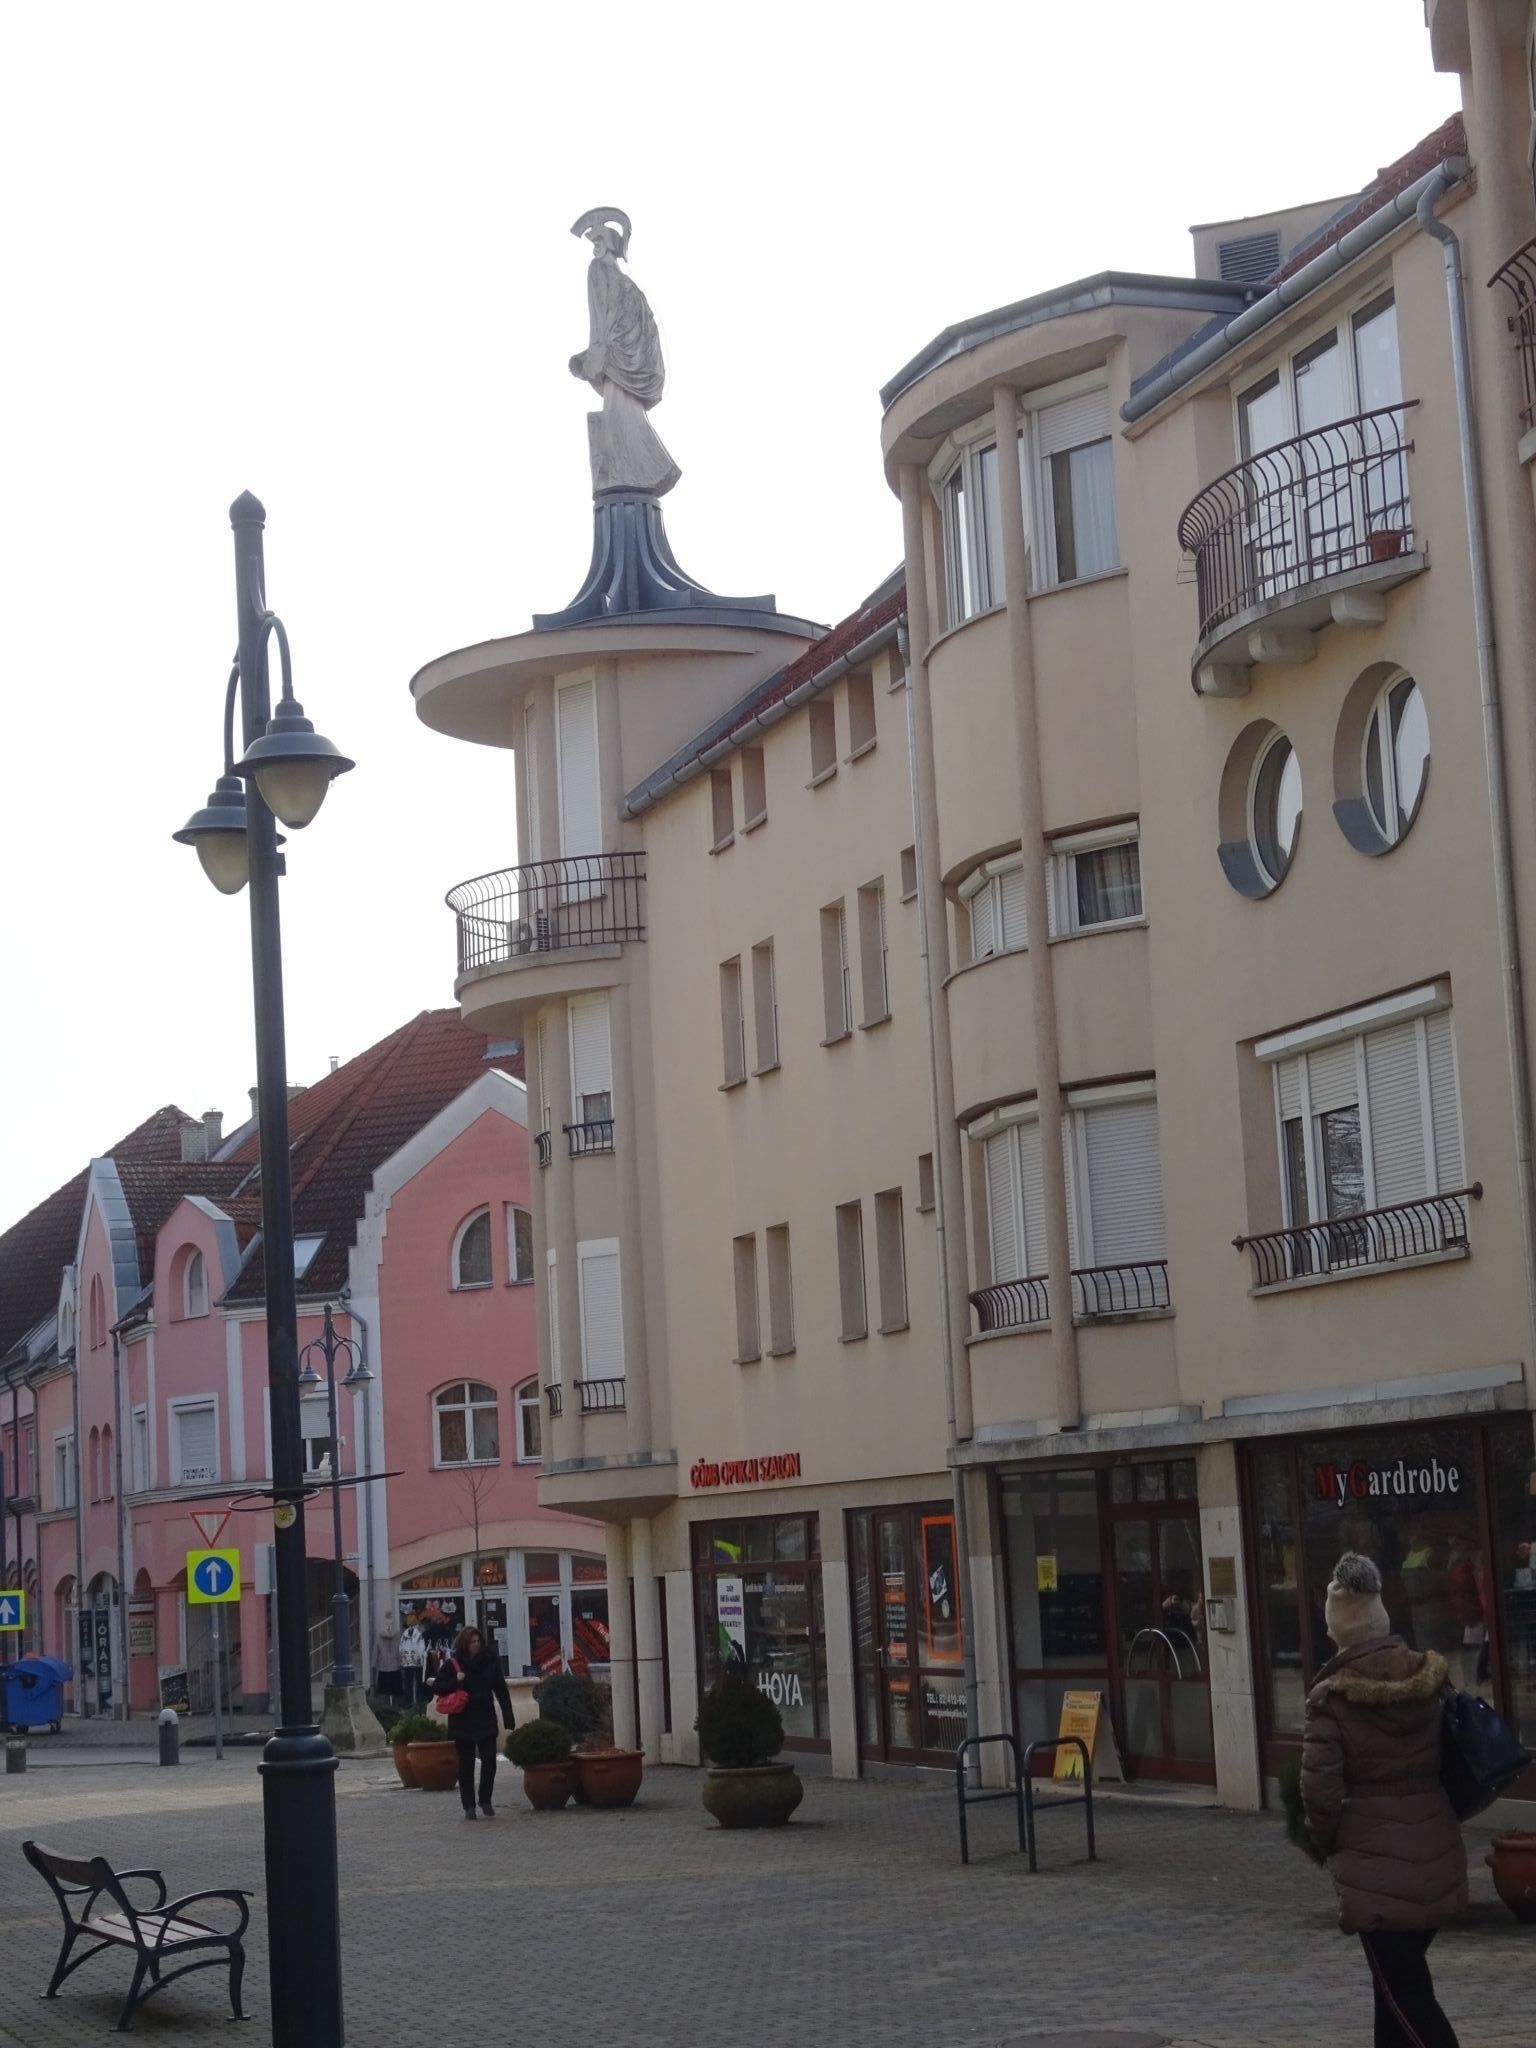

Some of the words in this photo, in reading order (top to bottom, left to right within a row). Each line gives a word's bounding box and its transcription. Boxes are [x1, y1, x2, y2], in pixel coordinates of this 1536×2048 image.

[690, 1457, 720, 1488] GÖMB
[720, 1458, 759, 1485] OPTIKAI
[759, 1452, 802, 1481] SZALON
[1314, 1458, 1460, 1507] MyGardrobe
[756, 1672, 803, 1706] HOYA
